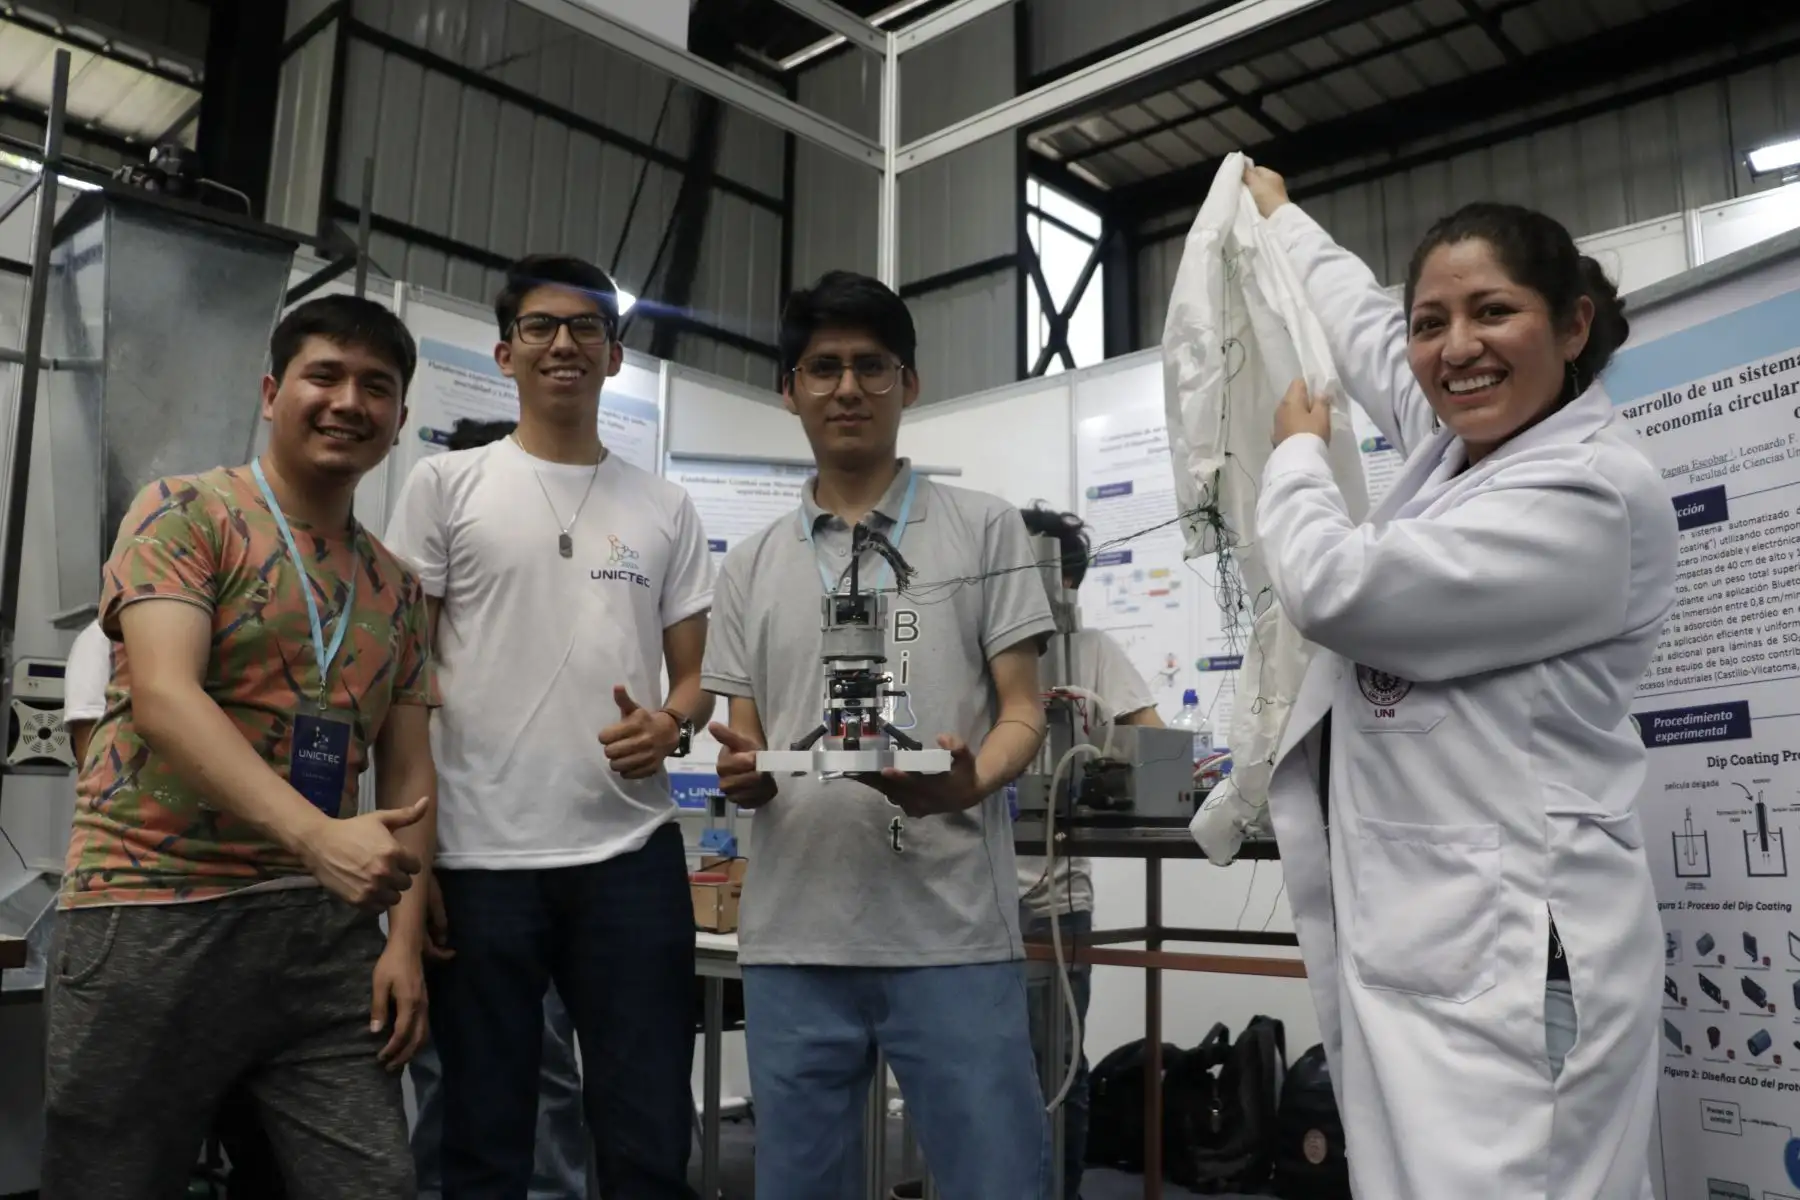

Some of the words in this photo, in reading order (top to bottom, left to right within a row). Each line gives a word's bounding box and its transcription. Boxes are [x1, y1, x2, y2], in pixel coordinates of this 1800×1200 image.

[1688, 384, 1707, 400] de
[1712, 376, 1734, 393] un
[1646, 402, 1723, 437] economía
[1728, 380, 1800, 413] circular
[1661, 464, 1690, 480] Zapata
[1692, 453, 1728, 470] Escobar
[1740, 437, 1786, 457] Leonardo
[1689, 467, 1728, 484] Facultad
[1730, 463, 1741, 474] de
[1743, 452, 1785, 470] Ciencias
[1691, 525, 1723, 538] sistema
[1728, 509, 1790, 530] automatizado
[1720, 529, 1761, 546] utilizando
[1700, 546, 1743, 562] inoxidable
[1744, 546, 1750, 555] y
[1715, 563, 1725, 573] de
[1727, 561, 1738, 570] 40
[1740, 559, 1753, 569] cm
[1755, 554, 1766, 564] de
[1768, 550, 1787, 563] alto
[590, 569, 651, 588] UNICTEC
[1693, 581, 1708, 591] con
[1711, 578, 1722, 587] un
[1725, 574, 1746, 586] peso
[1748, 568, 1770, 579] total
[1707, 591, 1722, 601] una
[1725, 584, 1769, 599] aplicación
[1682, 605, 1723, 619] inmersión
[1725, 601, 1749, 611] entre
[1750, 597, 1764, 608] 0,8
[1673, 624, 1681, 633] la
[1683, 618, 1723, 632] adsorción
[1726, 615, 1738, 624] de
[1741, 609, 1779, 623] petróleo
[1782, 607, 1794, 615] en
[1674, 631, 1714, 647] aplicación
[1717, 625, 1754, 640] eficiente
[1667, 648, 1703, 661] adicional
[1706, 644, 1725, 655] para
[1729, 640, 1763, 652] láminas
[1767, 635, 1778, 645] de
[1656, 666, 1673, 677] Este
[1675, 662, 1704, 674] equipo
[1706, 658, 1717, 668] de
[1719, 655, 1738, 667] bajo
[1741, 653, 1765, 664] costo
[1666, 673, 1713, 688] industriales
[1374, 708, 1395, 719] UNI
[1653, 710, 1733, 729] Procedimiento
[1655, 724, 1728, 743] experimental
[298, 748, 340, 764] UNICTEC
[1707, 755, 1728, 770] Dip
[1729, 751, 1779, 766] Coating
[1687, 901, 1720, 910] Proceso
[1722, 900, 1736, 910] del
[1738, 901, 1754, 912] Dip
[1756, 901, 1792, 913] Coating
[1664, 1066, 1690, 1079] Figura
[1692, 1069, 1700, 1079] 2:
[1702, 1071, 1736, 1085] Diseños
[1738, 1075, 1758, 1087] CAD
[1761, 1078, 1776, 1089] del
